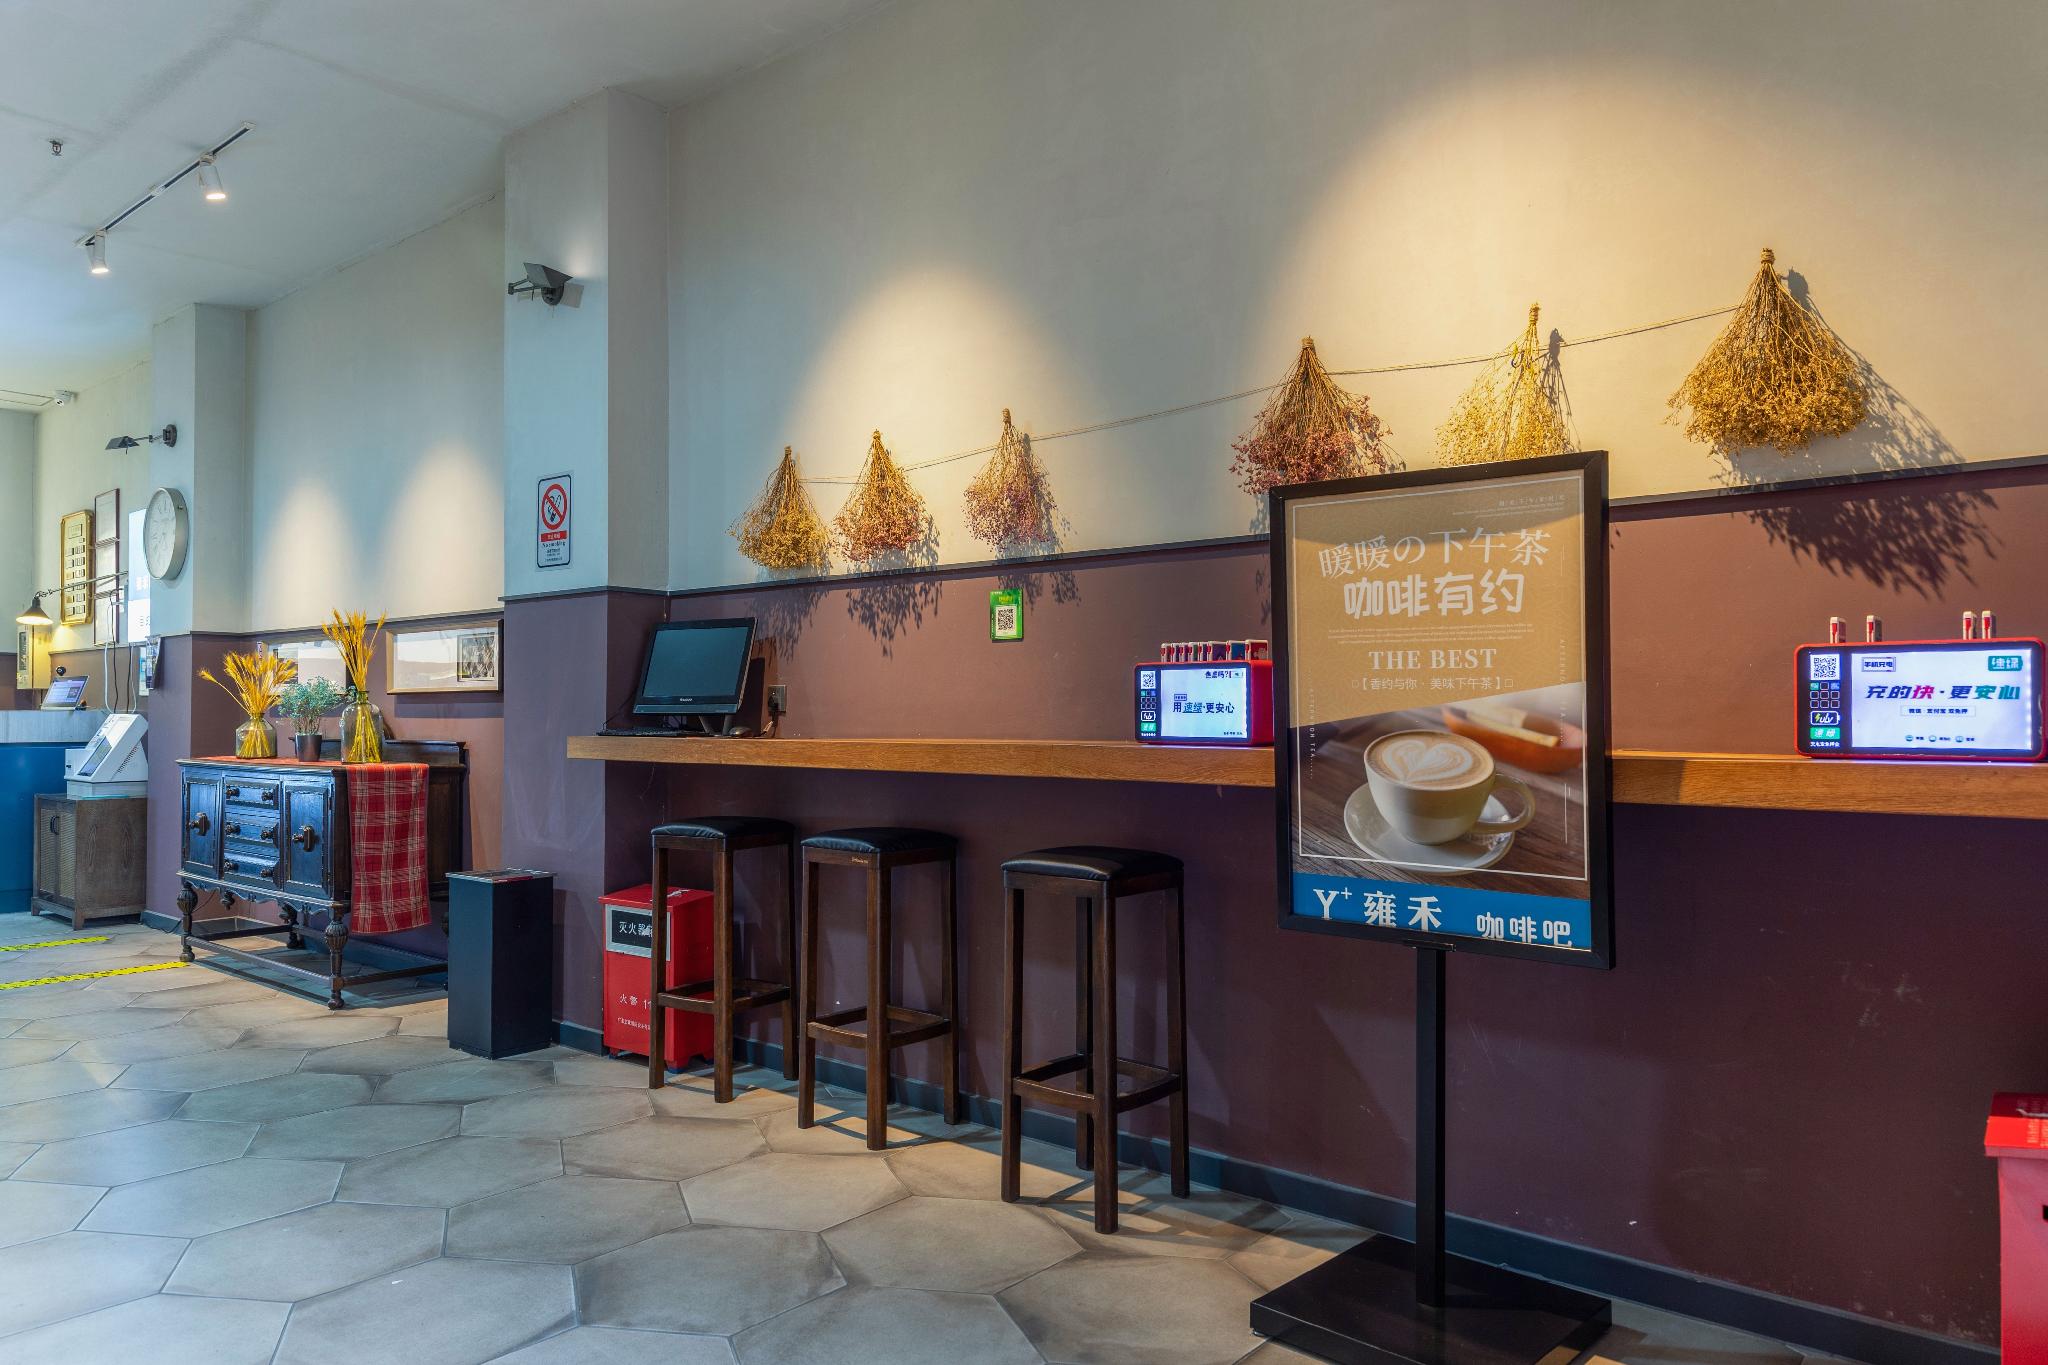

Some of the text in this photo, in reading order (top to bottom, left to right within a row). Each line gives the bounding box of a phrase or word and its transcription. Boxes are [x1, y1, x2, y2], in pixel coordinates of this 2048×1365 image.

[1318, 527, 1552, 579] 暖暖の下午茶
[1343, 569, 1525, 620] 咖啡有约
[1368, 648, 1497, 670] THE BEST
[1363, 890, 1443, 933] 雍禾
[1475, 911, 1573, 948] 咖啡吧
[619, 993, 638, 1006] 火警
